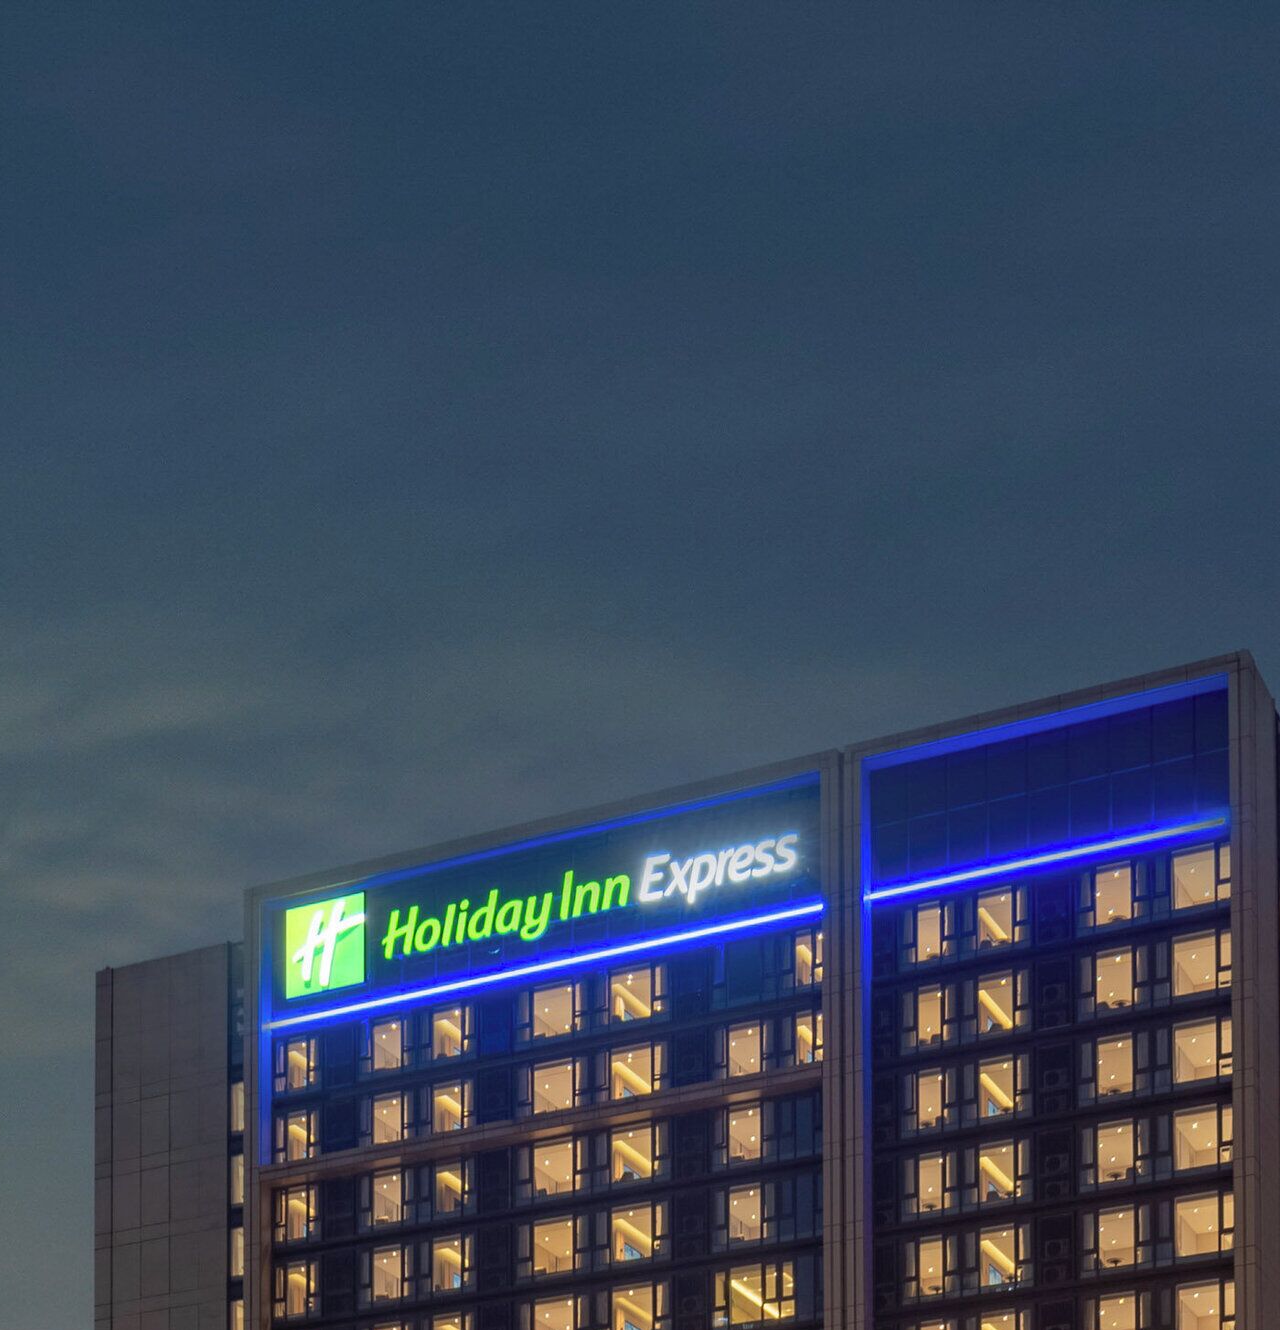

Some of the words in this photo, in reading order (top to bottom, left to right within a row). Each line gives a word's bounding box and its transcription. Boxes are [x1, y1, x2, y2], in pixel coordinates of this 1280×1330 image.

[381, 889, 553, 961] Holiday
[560, 869, 631, 922] Inn
[637, 832, 799, 904] Express
